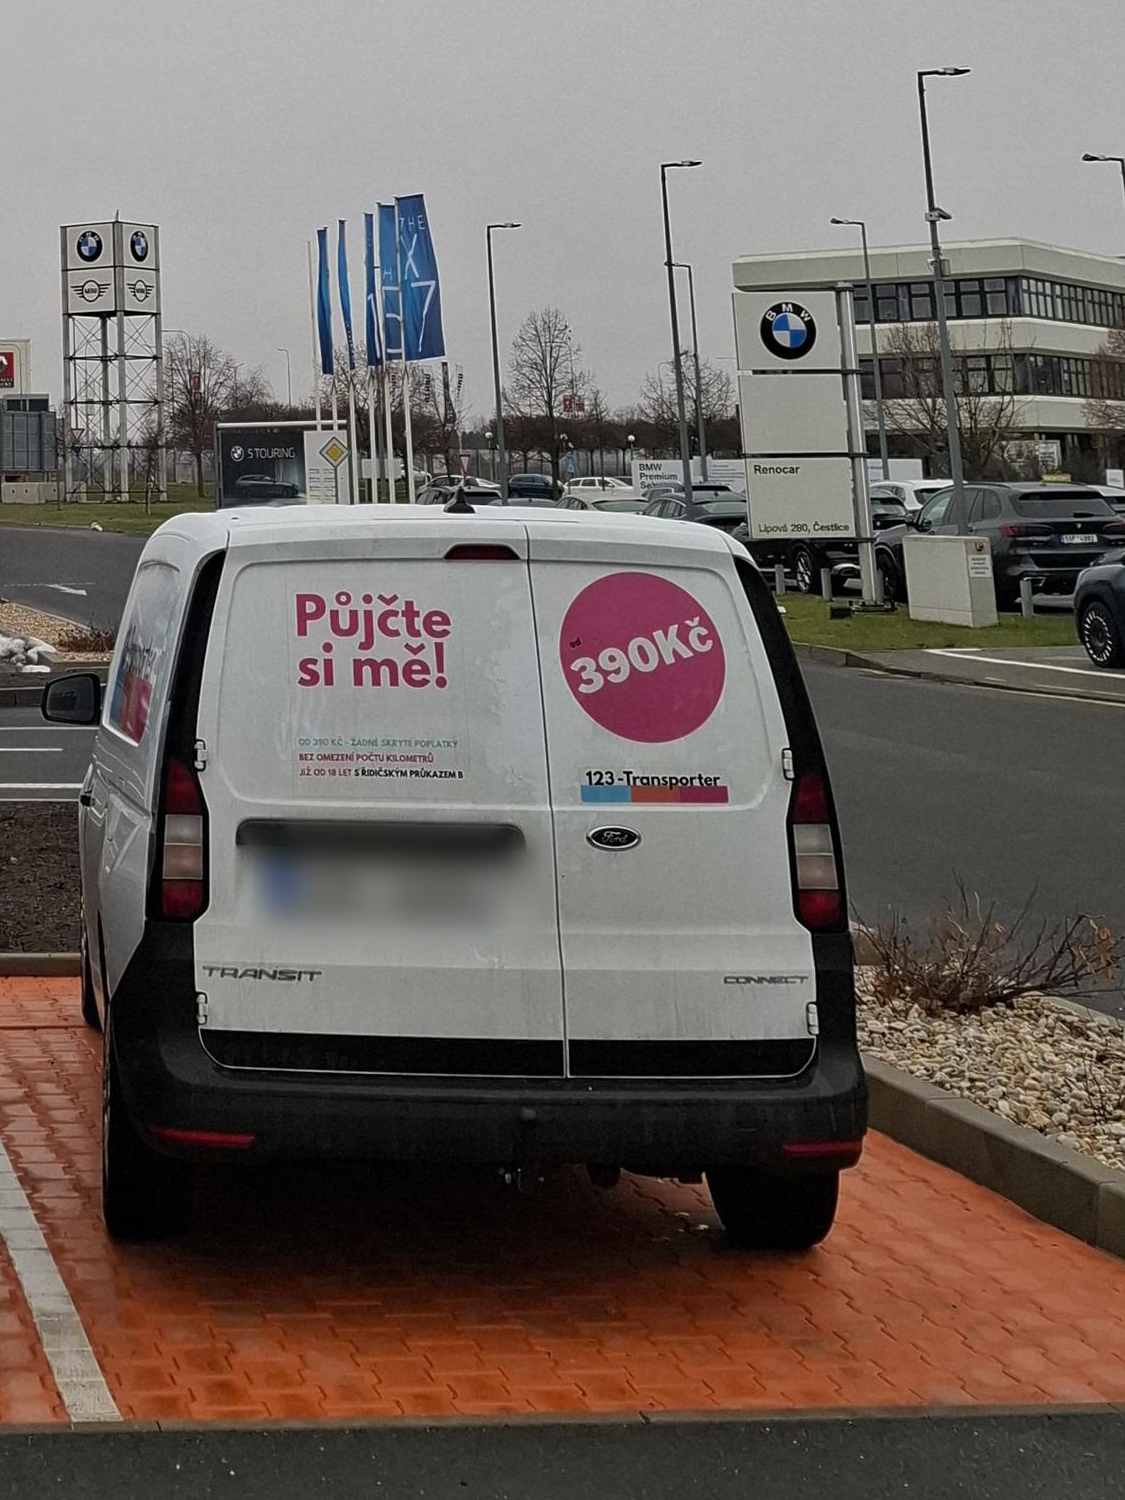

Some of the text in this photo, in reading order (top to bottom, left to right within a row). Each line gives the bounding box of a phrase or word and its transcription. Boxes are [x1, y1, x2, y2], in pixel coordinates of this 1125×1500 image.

[765, 303, 811, 322] BMW
[254, 447, 296, 459] TOURING
[638, 463, 663, 471] BMW
[753, 464, 801, 475] Renocar
[639, 472, 678, 481] Premium
[758, 523, 788, 534] Lipová
[295, 591, 452, 651] Půjčte
[569, 637, 582, 649] od
[570, 616, 713, 694] 390Kč
[298, 642, 448, 689] si mě!
[299, 753, 314, 762] BEZ
[356, 751, 384, 762] POČTU
[338, 769, 352, 777] LET
[354, 769, 360, 778] S
[361, 766, 408, 779] ŘIDIČSKÝM
[409, 767, 457, 779] PRŮKAZEM
[458, 770, 464, 779] B
[202, 965, 322, 982] TRANSIT
[723, 975, 808, 984] CONNECT
